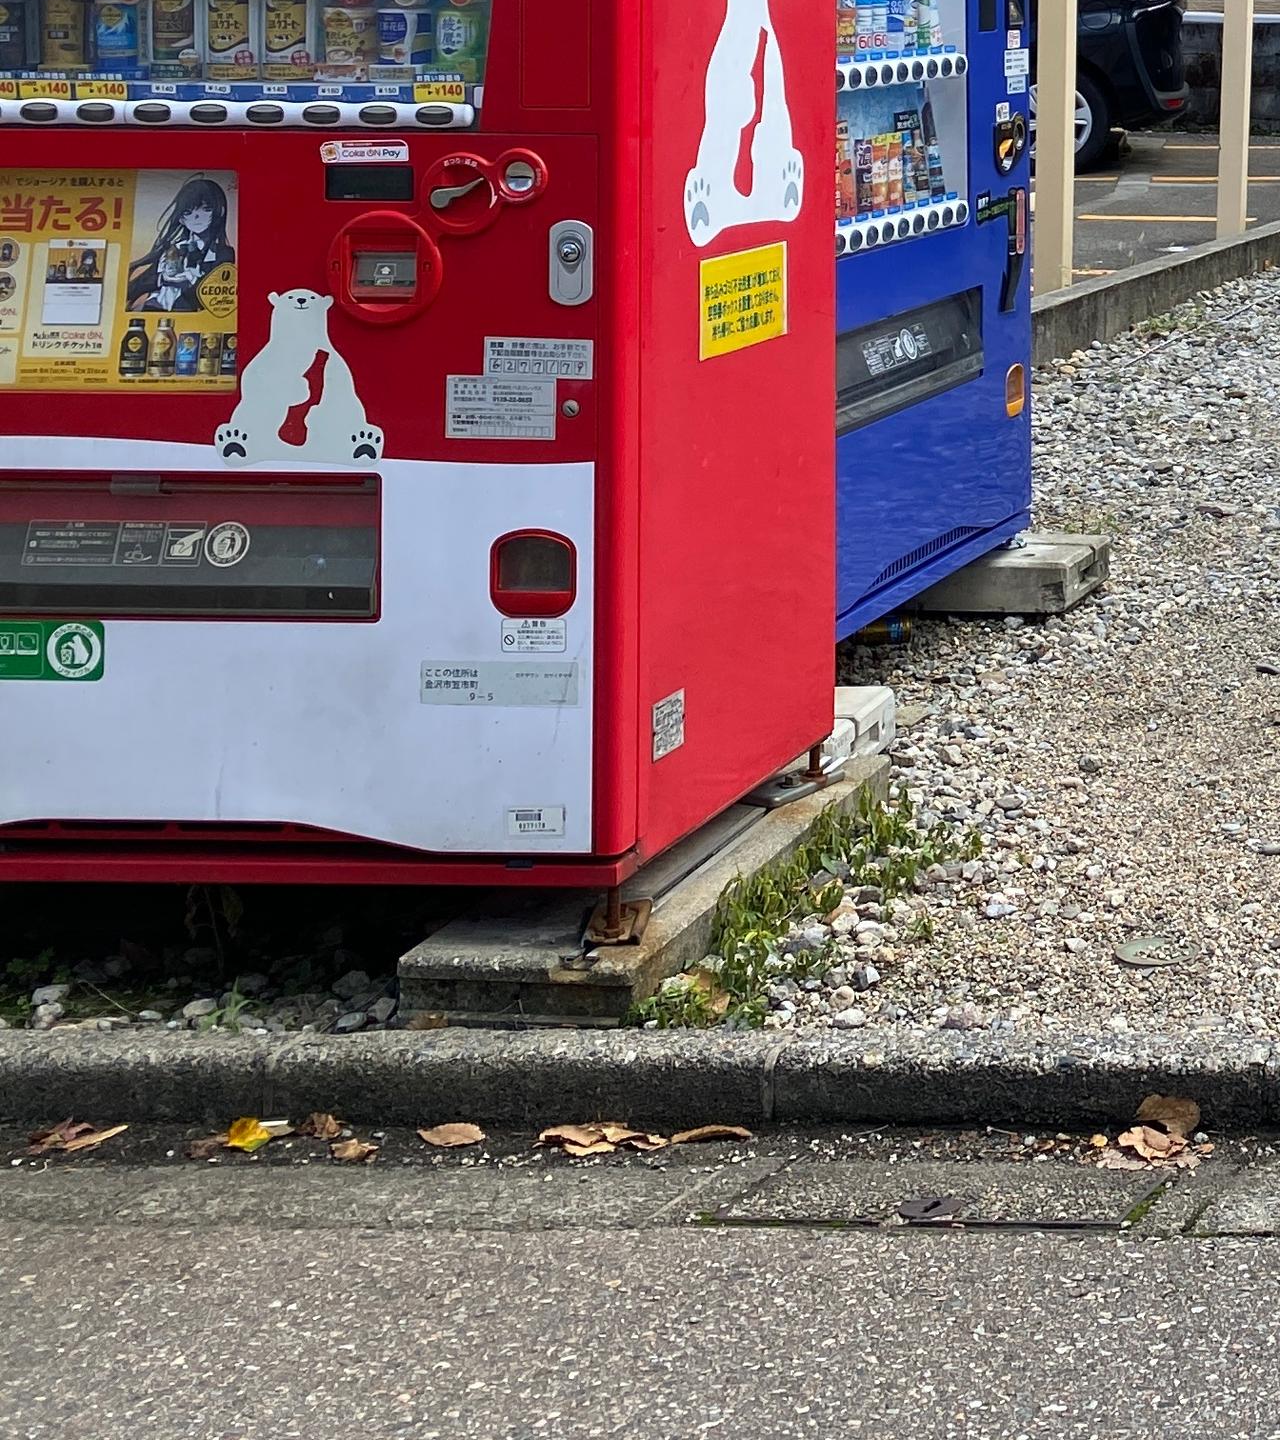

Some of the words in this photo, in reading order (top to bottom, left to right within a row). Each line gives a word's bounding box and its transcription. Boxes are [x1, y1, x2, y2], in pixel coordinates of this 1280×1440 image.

[40, 82, 68, 94] ¥140
[97, 83, 124, 95] ¥140
[435, 85, 463, 96] ¥140
[342, 150, 365, 158] Coke
[382, 149, 400, 158] Pay
[425, 669, 478, 677] ここの住所は
[425, 679, 478, 689] 金沢市笠市町
